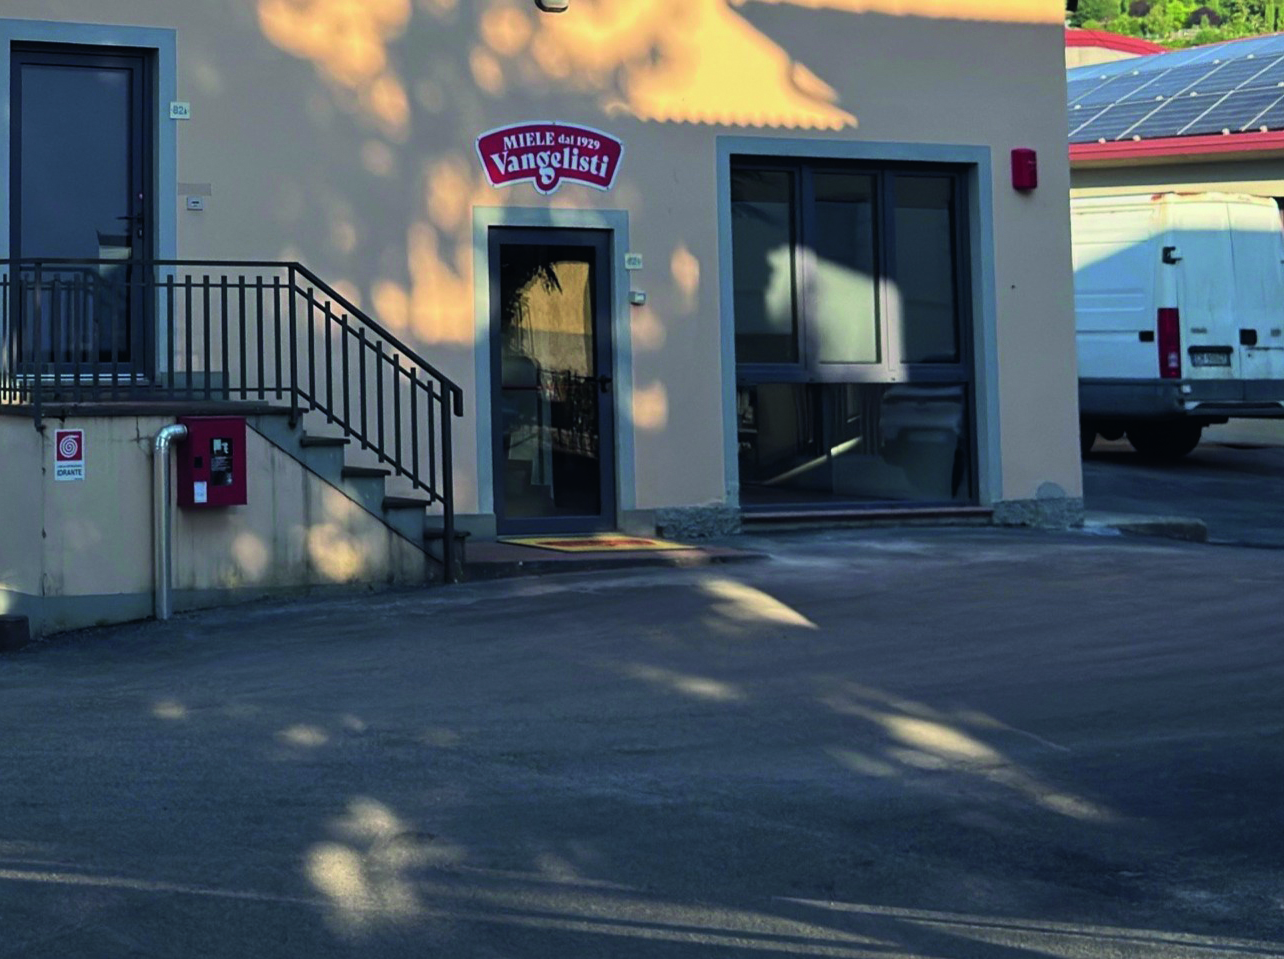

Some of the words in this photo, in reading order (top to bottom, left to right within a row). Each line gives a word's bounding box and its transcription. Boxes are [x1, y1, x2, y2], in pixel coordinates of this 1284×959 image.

[503, 132, 555, 151] MIELE
[558, 134, 573, 145] dal
[577, 136, 600, 150] 1929
[490, 147, 609, 185] Vangelisti
